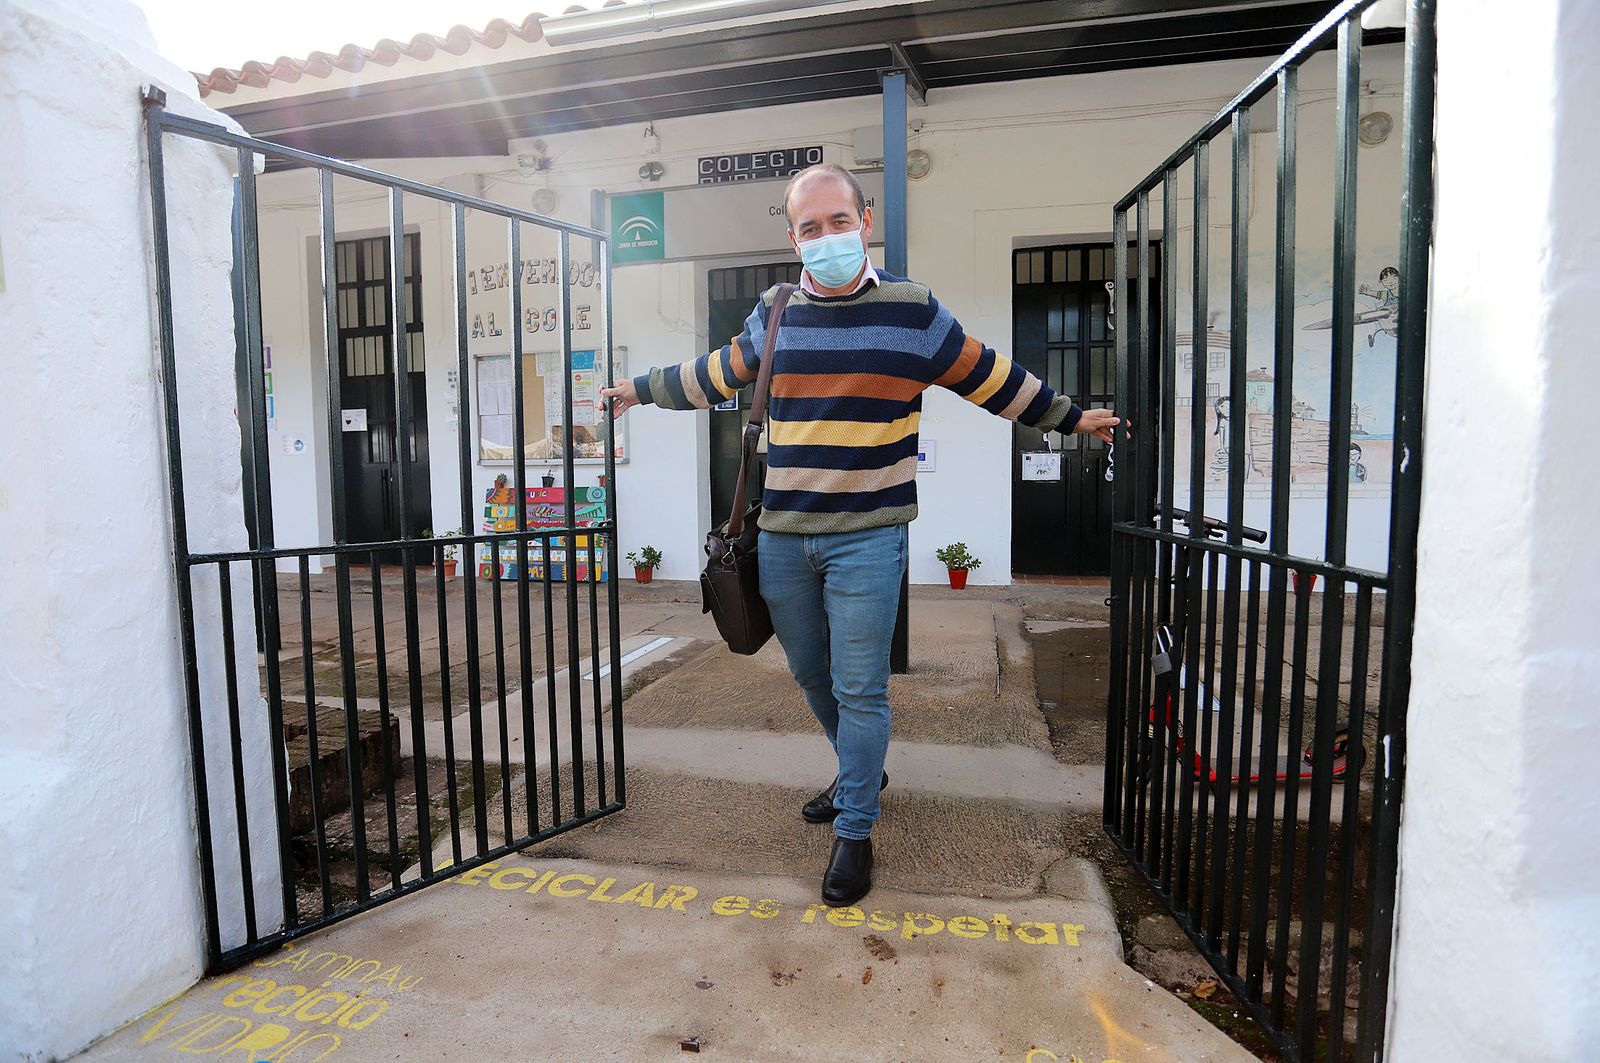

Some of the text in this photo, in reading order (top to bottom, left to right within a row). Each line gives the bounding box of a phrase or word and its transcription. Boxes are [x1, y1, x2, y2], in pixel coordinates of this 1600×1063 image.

[699, 147, 822, 175] COLEGIO
[472, 305, 591, 338] AL COE
[712, 894, 781, 920] es
[801, 903, 1086, 947] respetar
